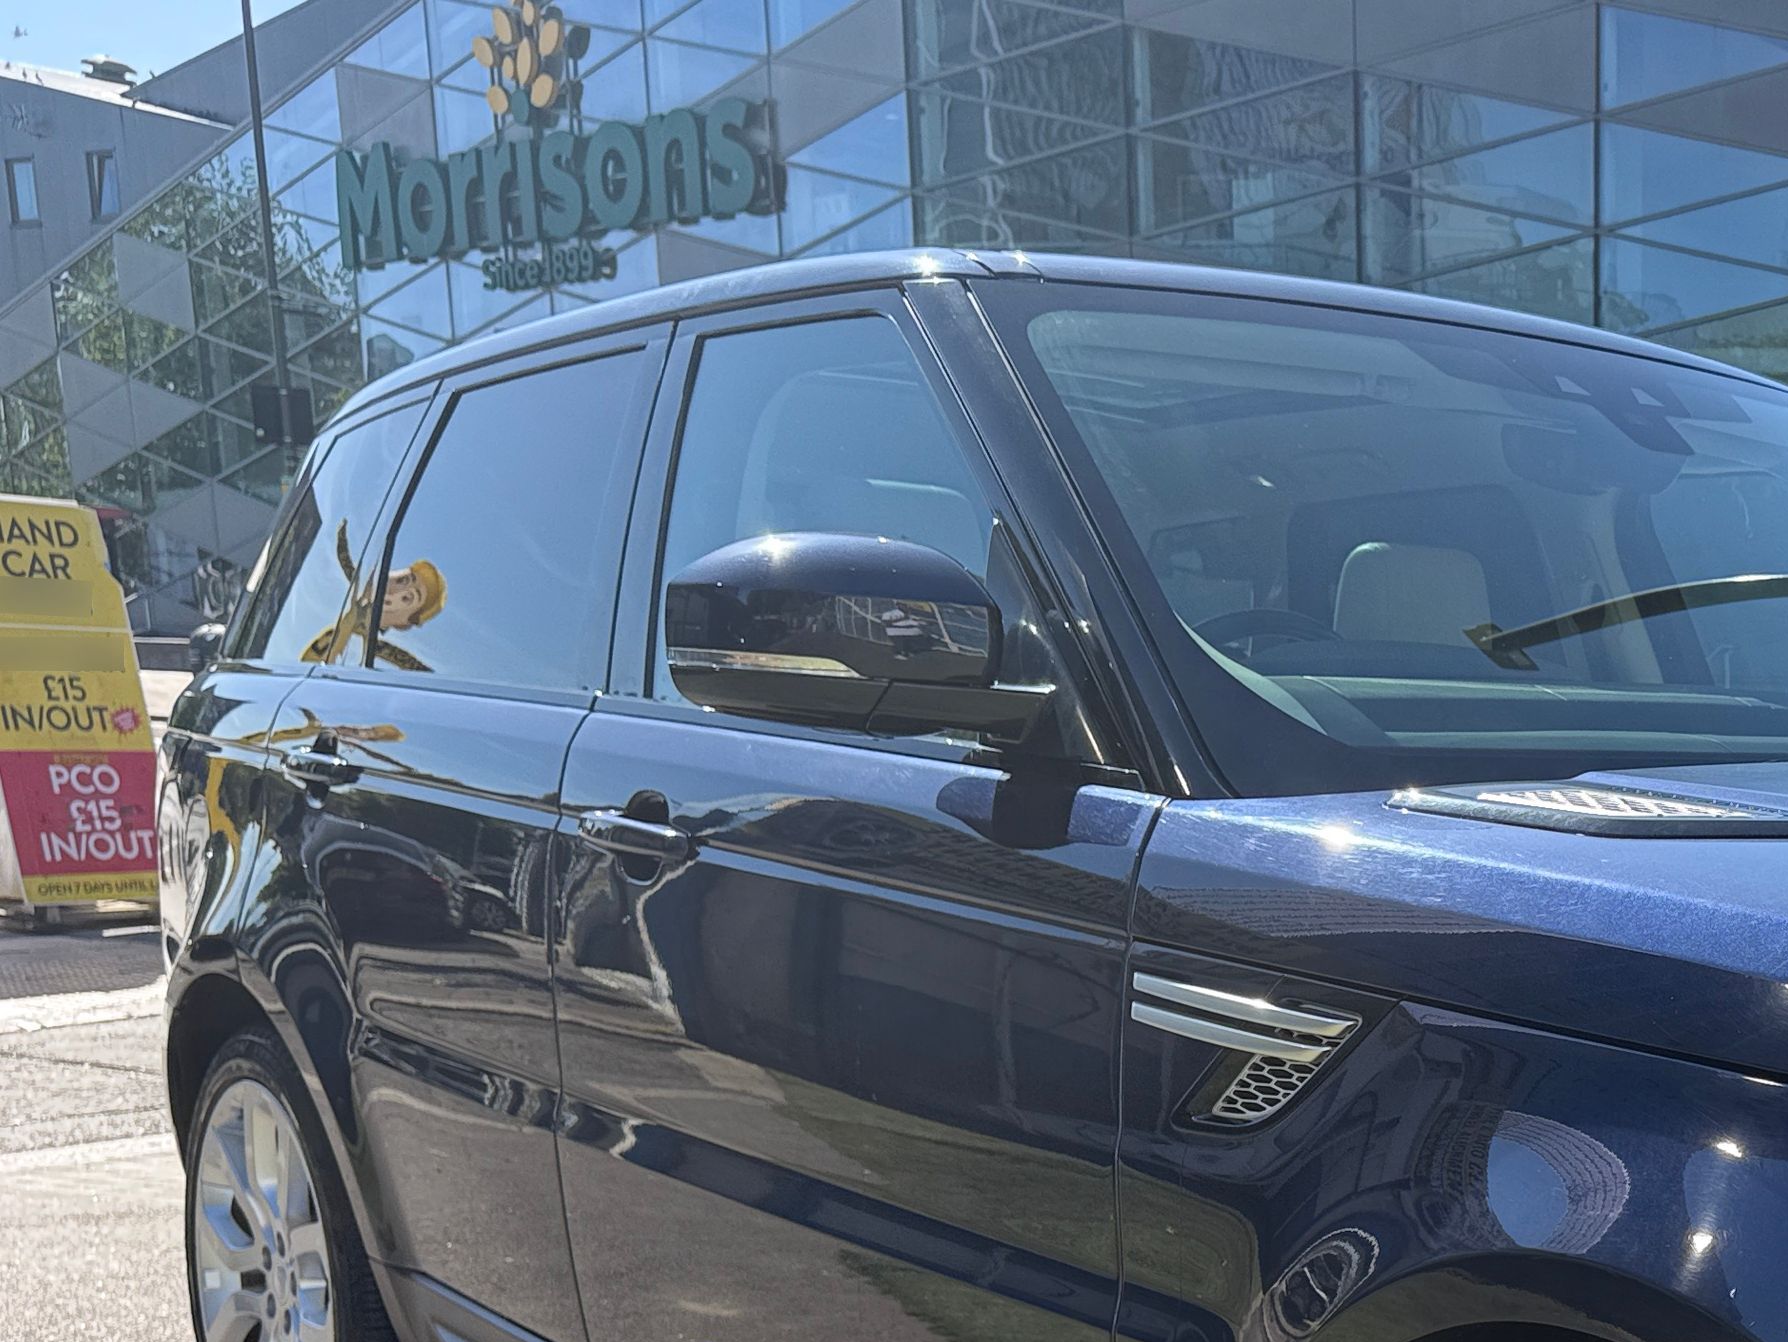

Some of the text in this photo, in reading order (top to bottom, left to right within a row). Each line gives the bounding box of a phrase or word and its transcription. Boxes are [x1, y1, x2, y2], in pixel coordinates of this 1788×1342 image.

[336, 100, 756, 270] Morrisons
[482, 243, 594, 290] Since 1899
[0, 516, 79, 548] AND
[1, 549, 71, 580] CAR
[43, 675, 87, 702] £15
[1, 704, 108, 733] IN/OUT
[48, 763, 120, 794] PCO
[69, 799, 122, 831] £15
[40, 828, 154, 862] IN/OUT
[39, 883, 72, 896] OPEN
[73, 881, 80, 895] 7
[84, 880, 113, 894] DAYS
